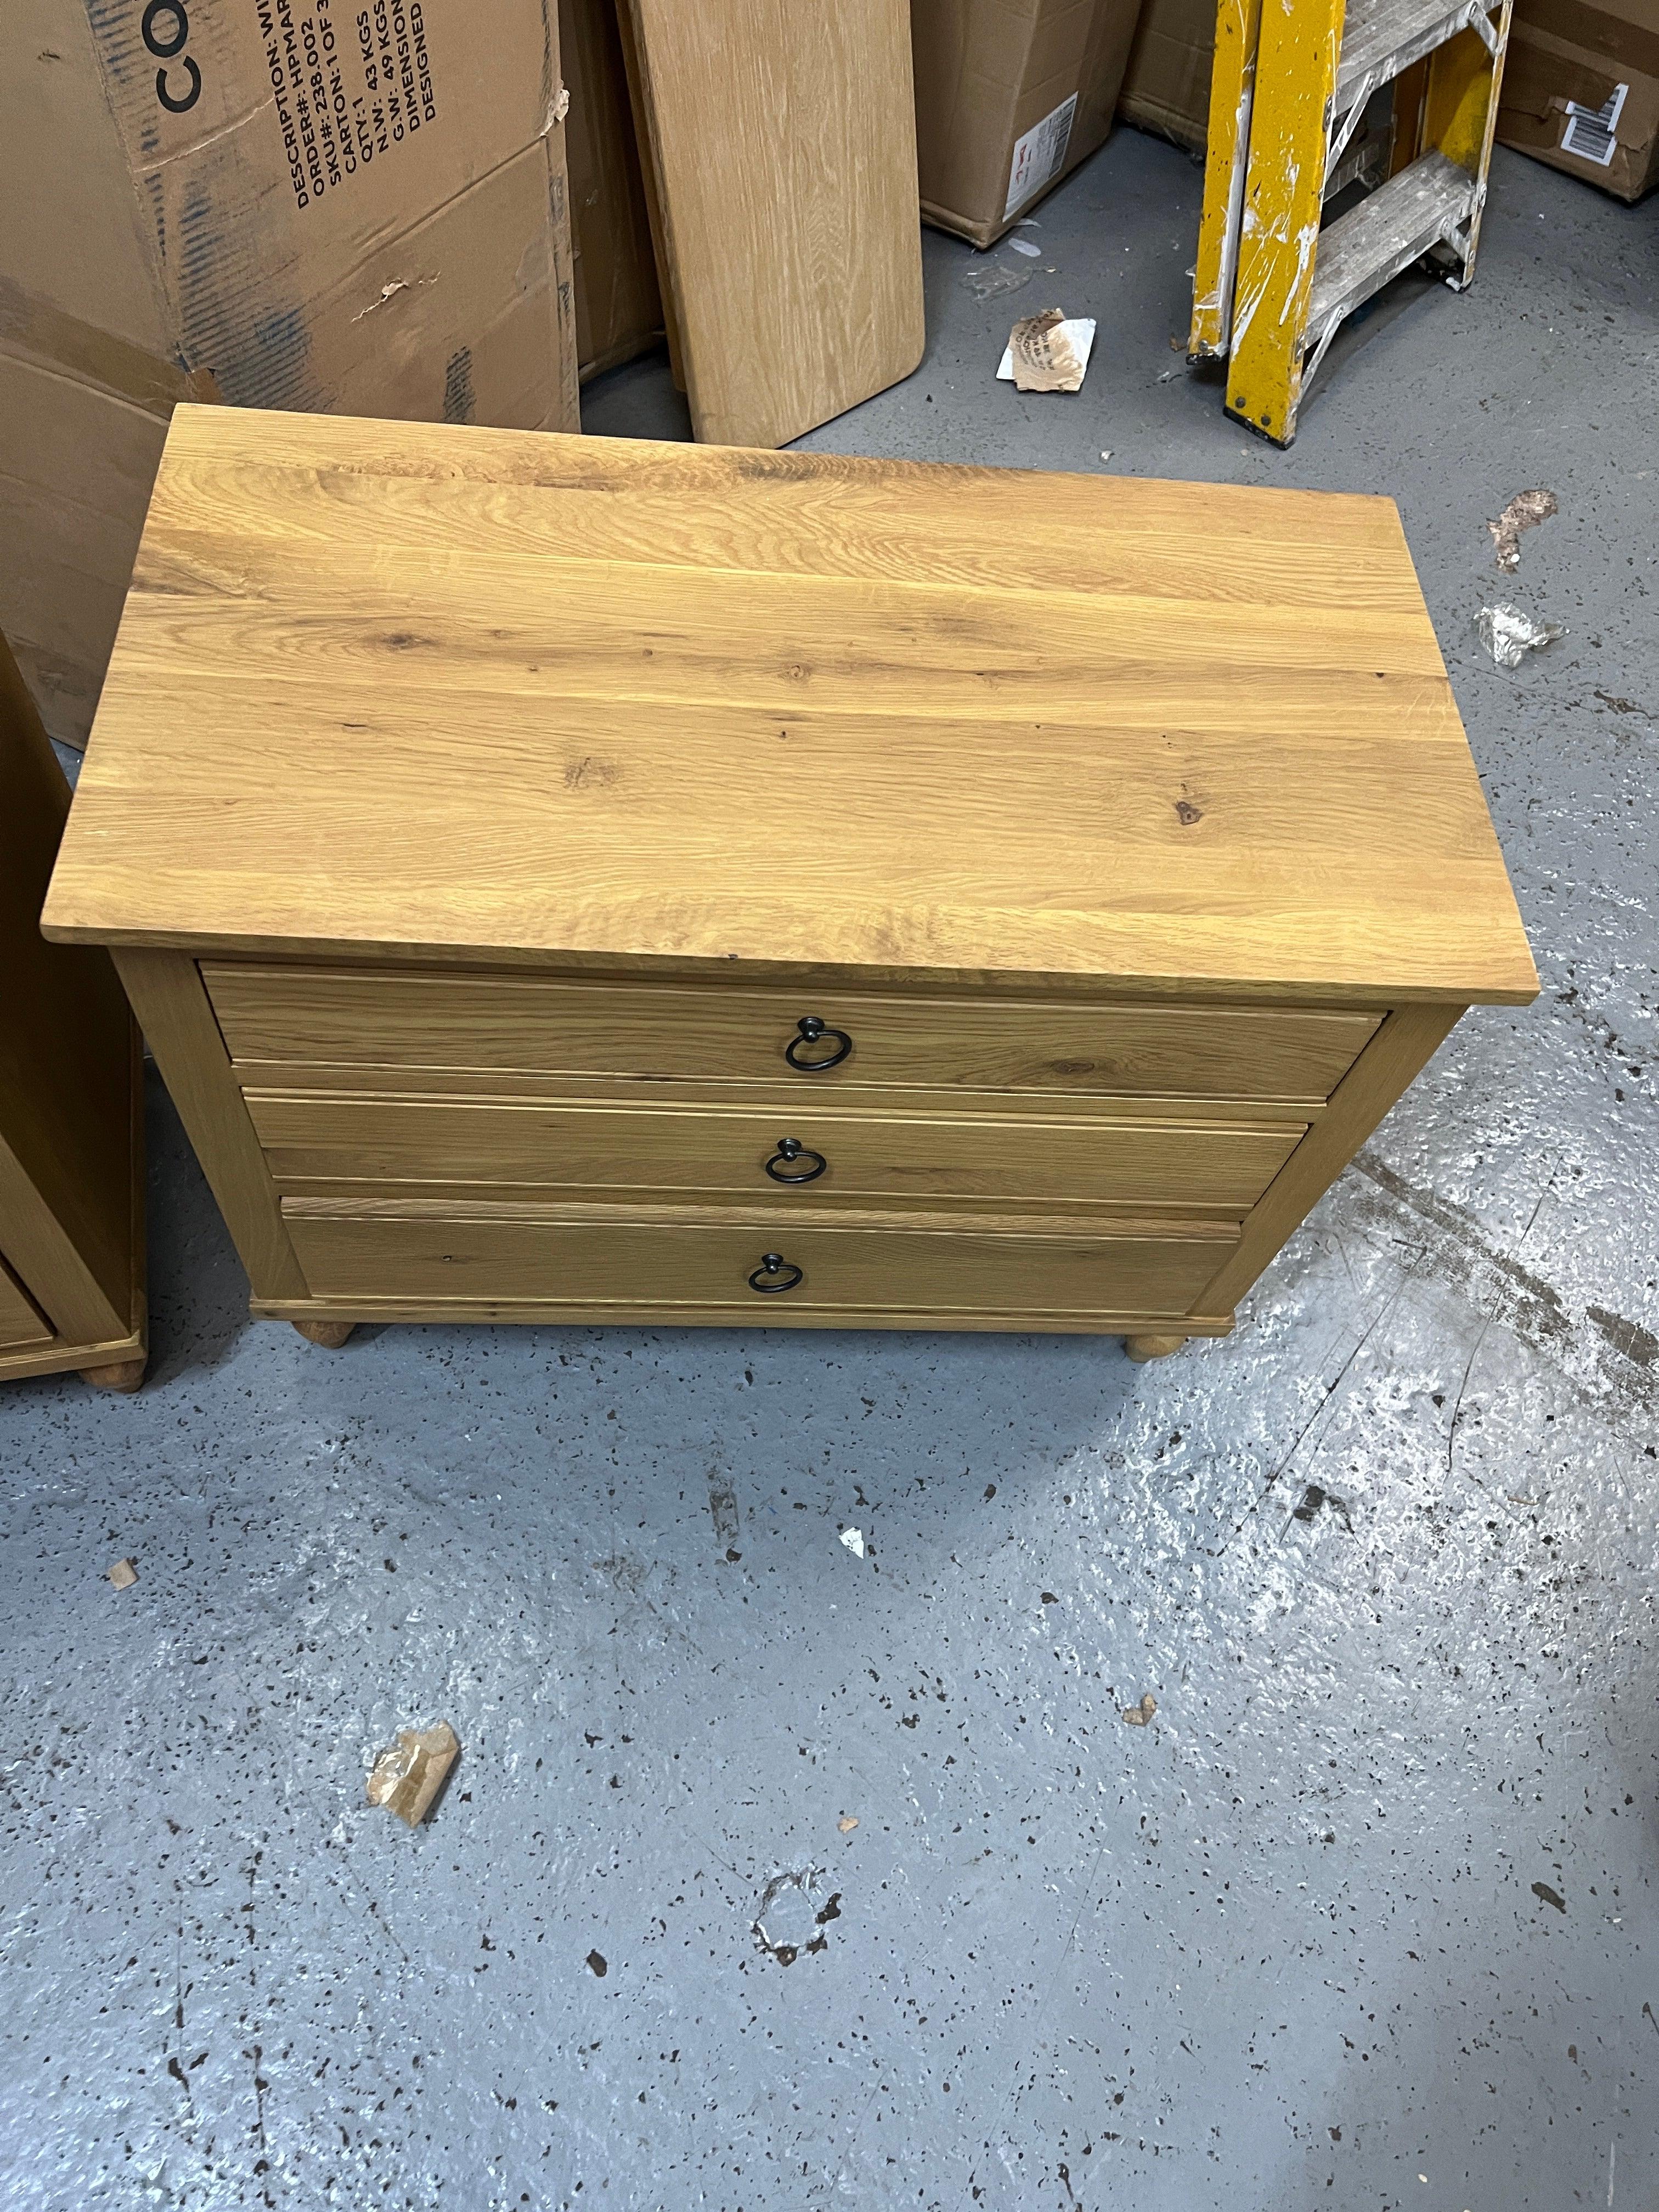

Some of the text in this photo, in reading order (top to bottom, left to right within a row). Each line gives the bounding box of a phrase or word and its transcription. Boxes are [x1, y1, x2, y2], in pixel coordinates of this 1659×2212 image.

[317, 0, 329, 13] 3
[319, 18, 334, 51] OF
[374, 0, 404, 142] G.W: 49 KGS
[391, 0, 420, 132] DIMENSION
[411, 3, 435, 122] DESIGNED
[256, 0, 309, 209] DESCRIPTION: WI
[296, 90, 324, 196] ORDER#:
[301, 18, 341, 186] SKU#: 238.002
[357, 11, 389, 153] N.W: 43 KGS
